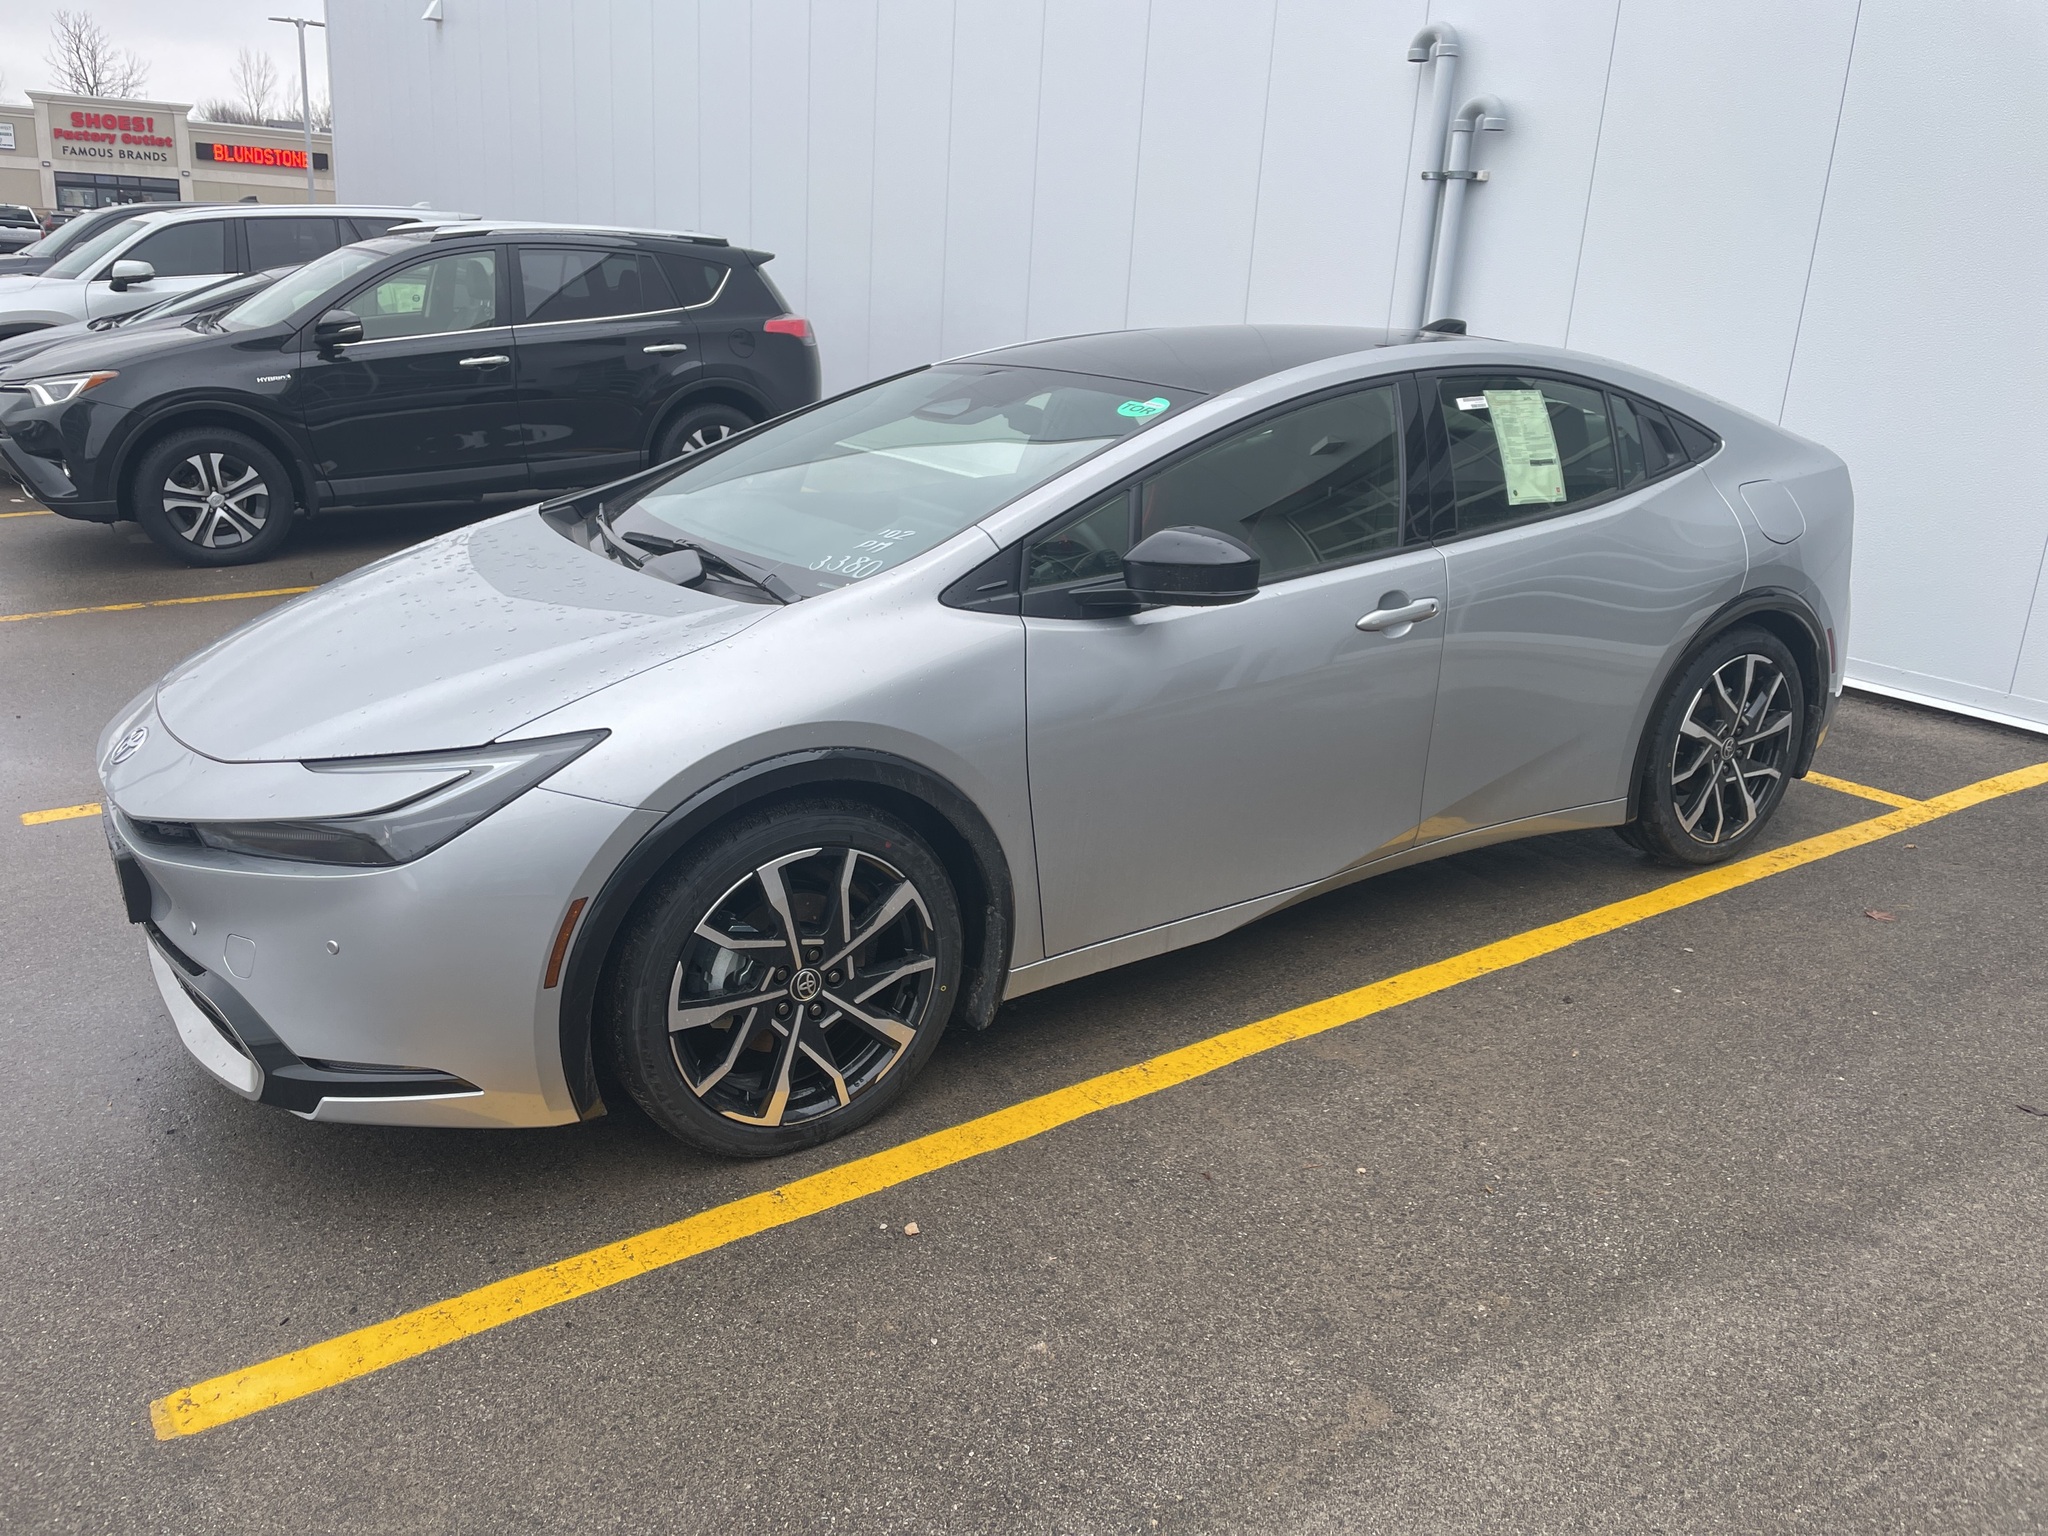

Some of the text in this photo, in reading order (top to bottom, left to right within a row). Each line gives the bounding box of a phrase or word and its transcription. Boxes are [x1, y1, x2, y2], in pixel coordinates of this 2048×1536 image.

[70, 111, 154, 133] SHOES!
[53, 127, 173, 148] Factory Outlet
[62, 145, 168, 162] FAMOUS BRANDS
[256, 375, 286, 383] HYBRID
[1122, 402, 1156, 415] TOR
[878, 528, 916, 541] 102
[808, 555, 884, 579] 3380
